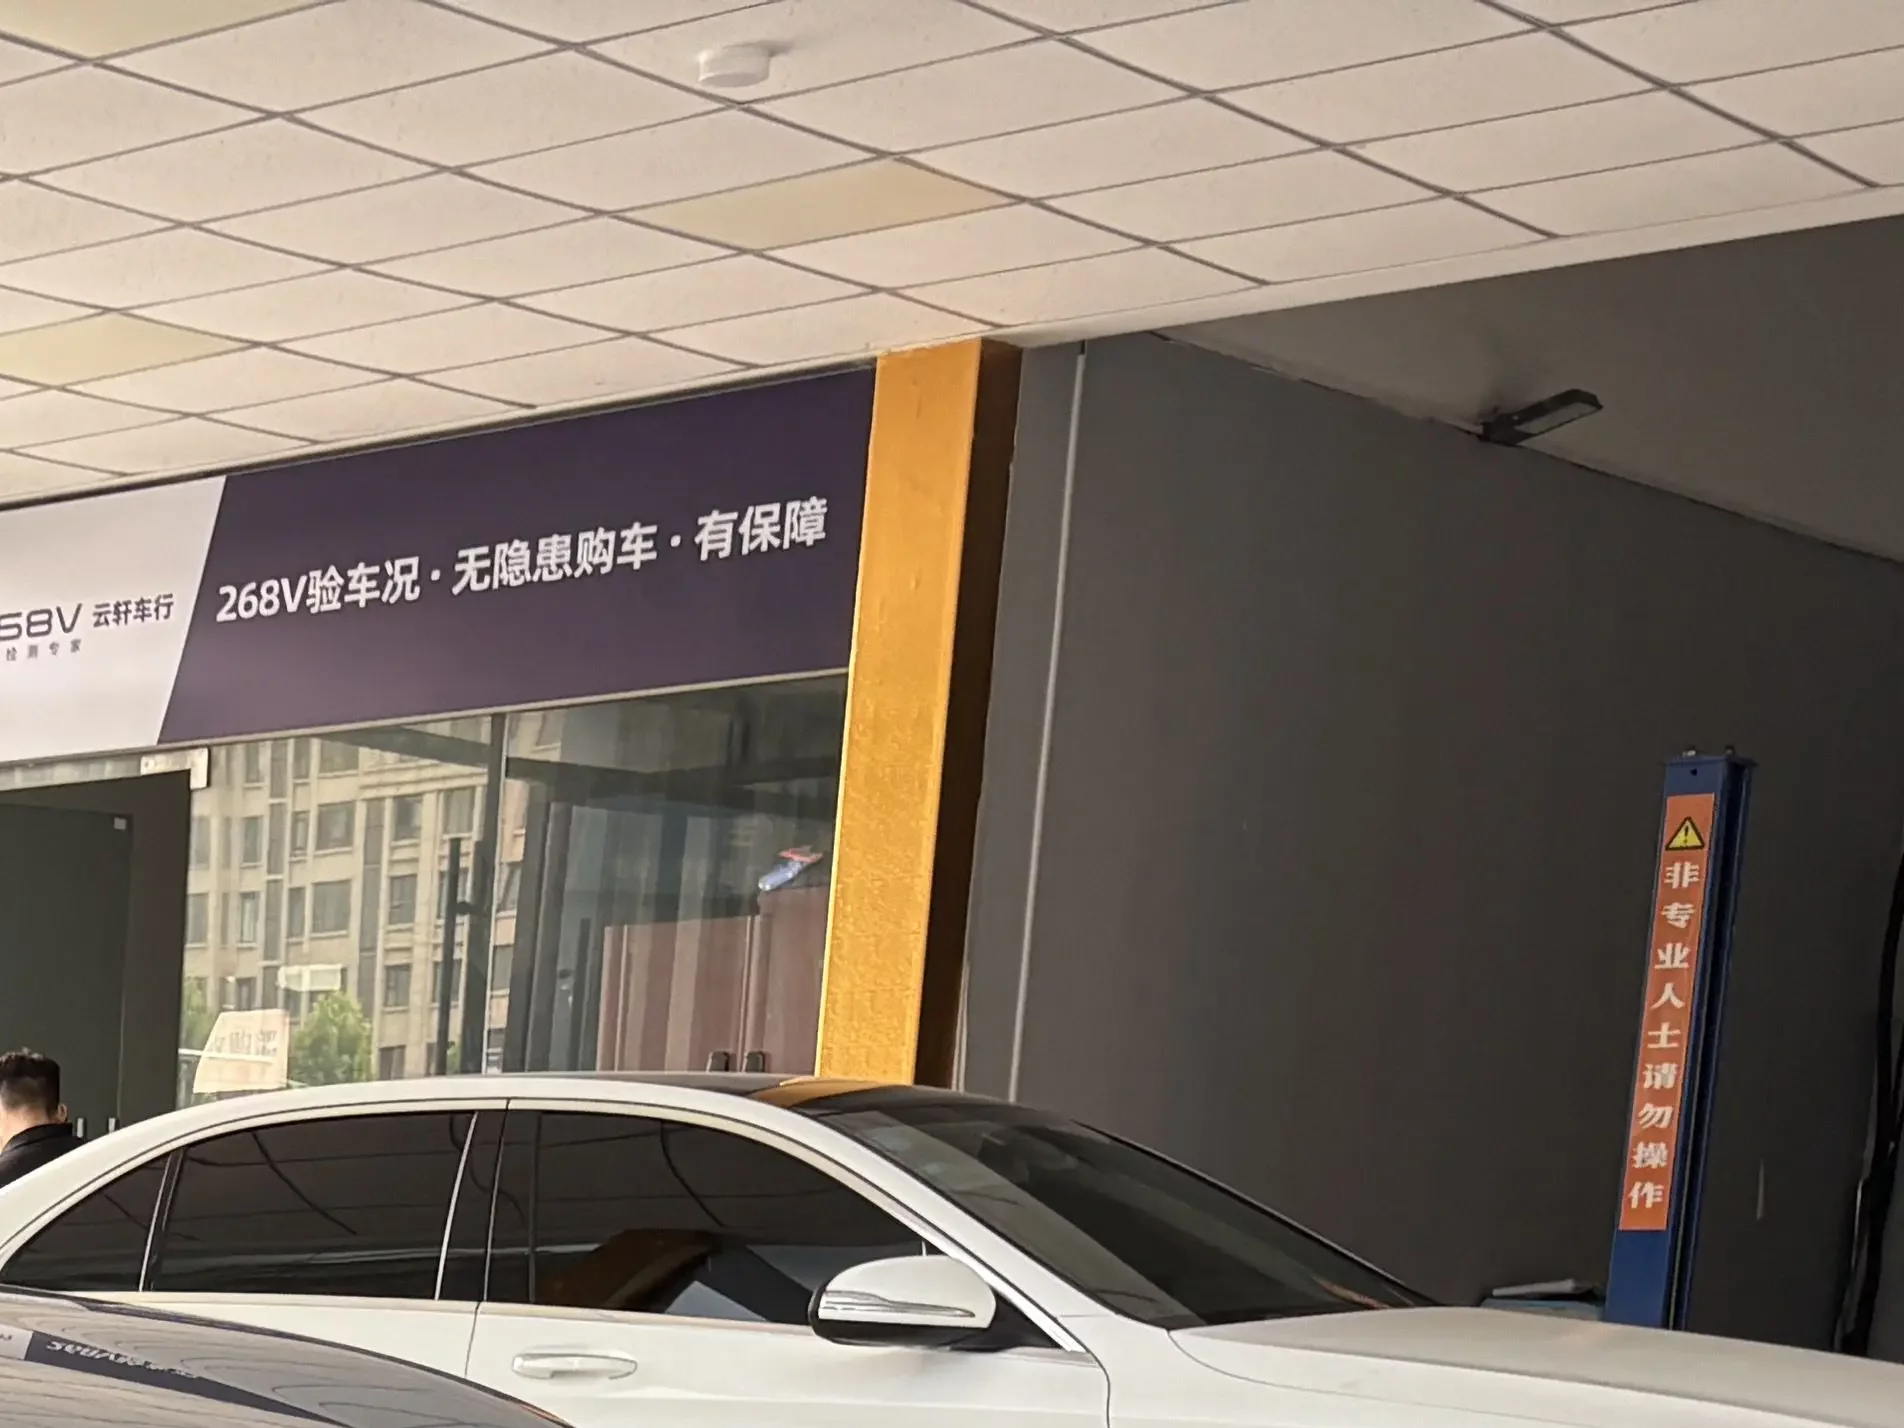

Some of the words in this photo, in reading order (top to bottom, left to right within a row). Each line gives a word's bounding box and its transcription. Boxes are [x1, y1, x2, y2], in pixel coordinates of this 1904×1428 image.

[92, 593, 175, 628] 云轩车行
[216, 496, 828, 624] 268V验车况·无隐患购车·有保障
[1628, 861, 1700, 1210] 非专业人士请勿操作
